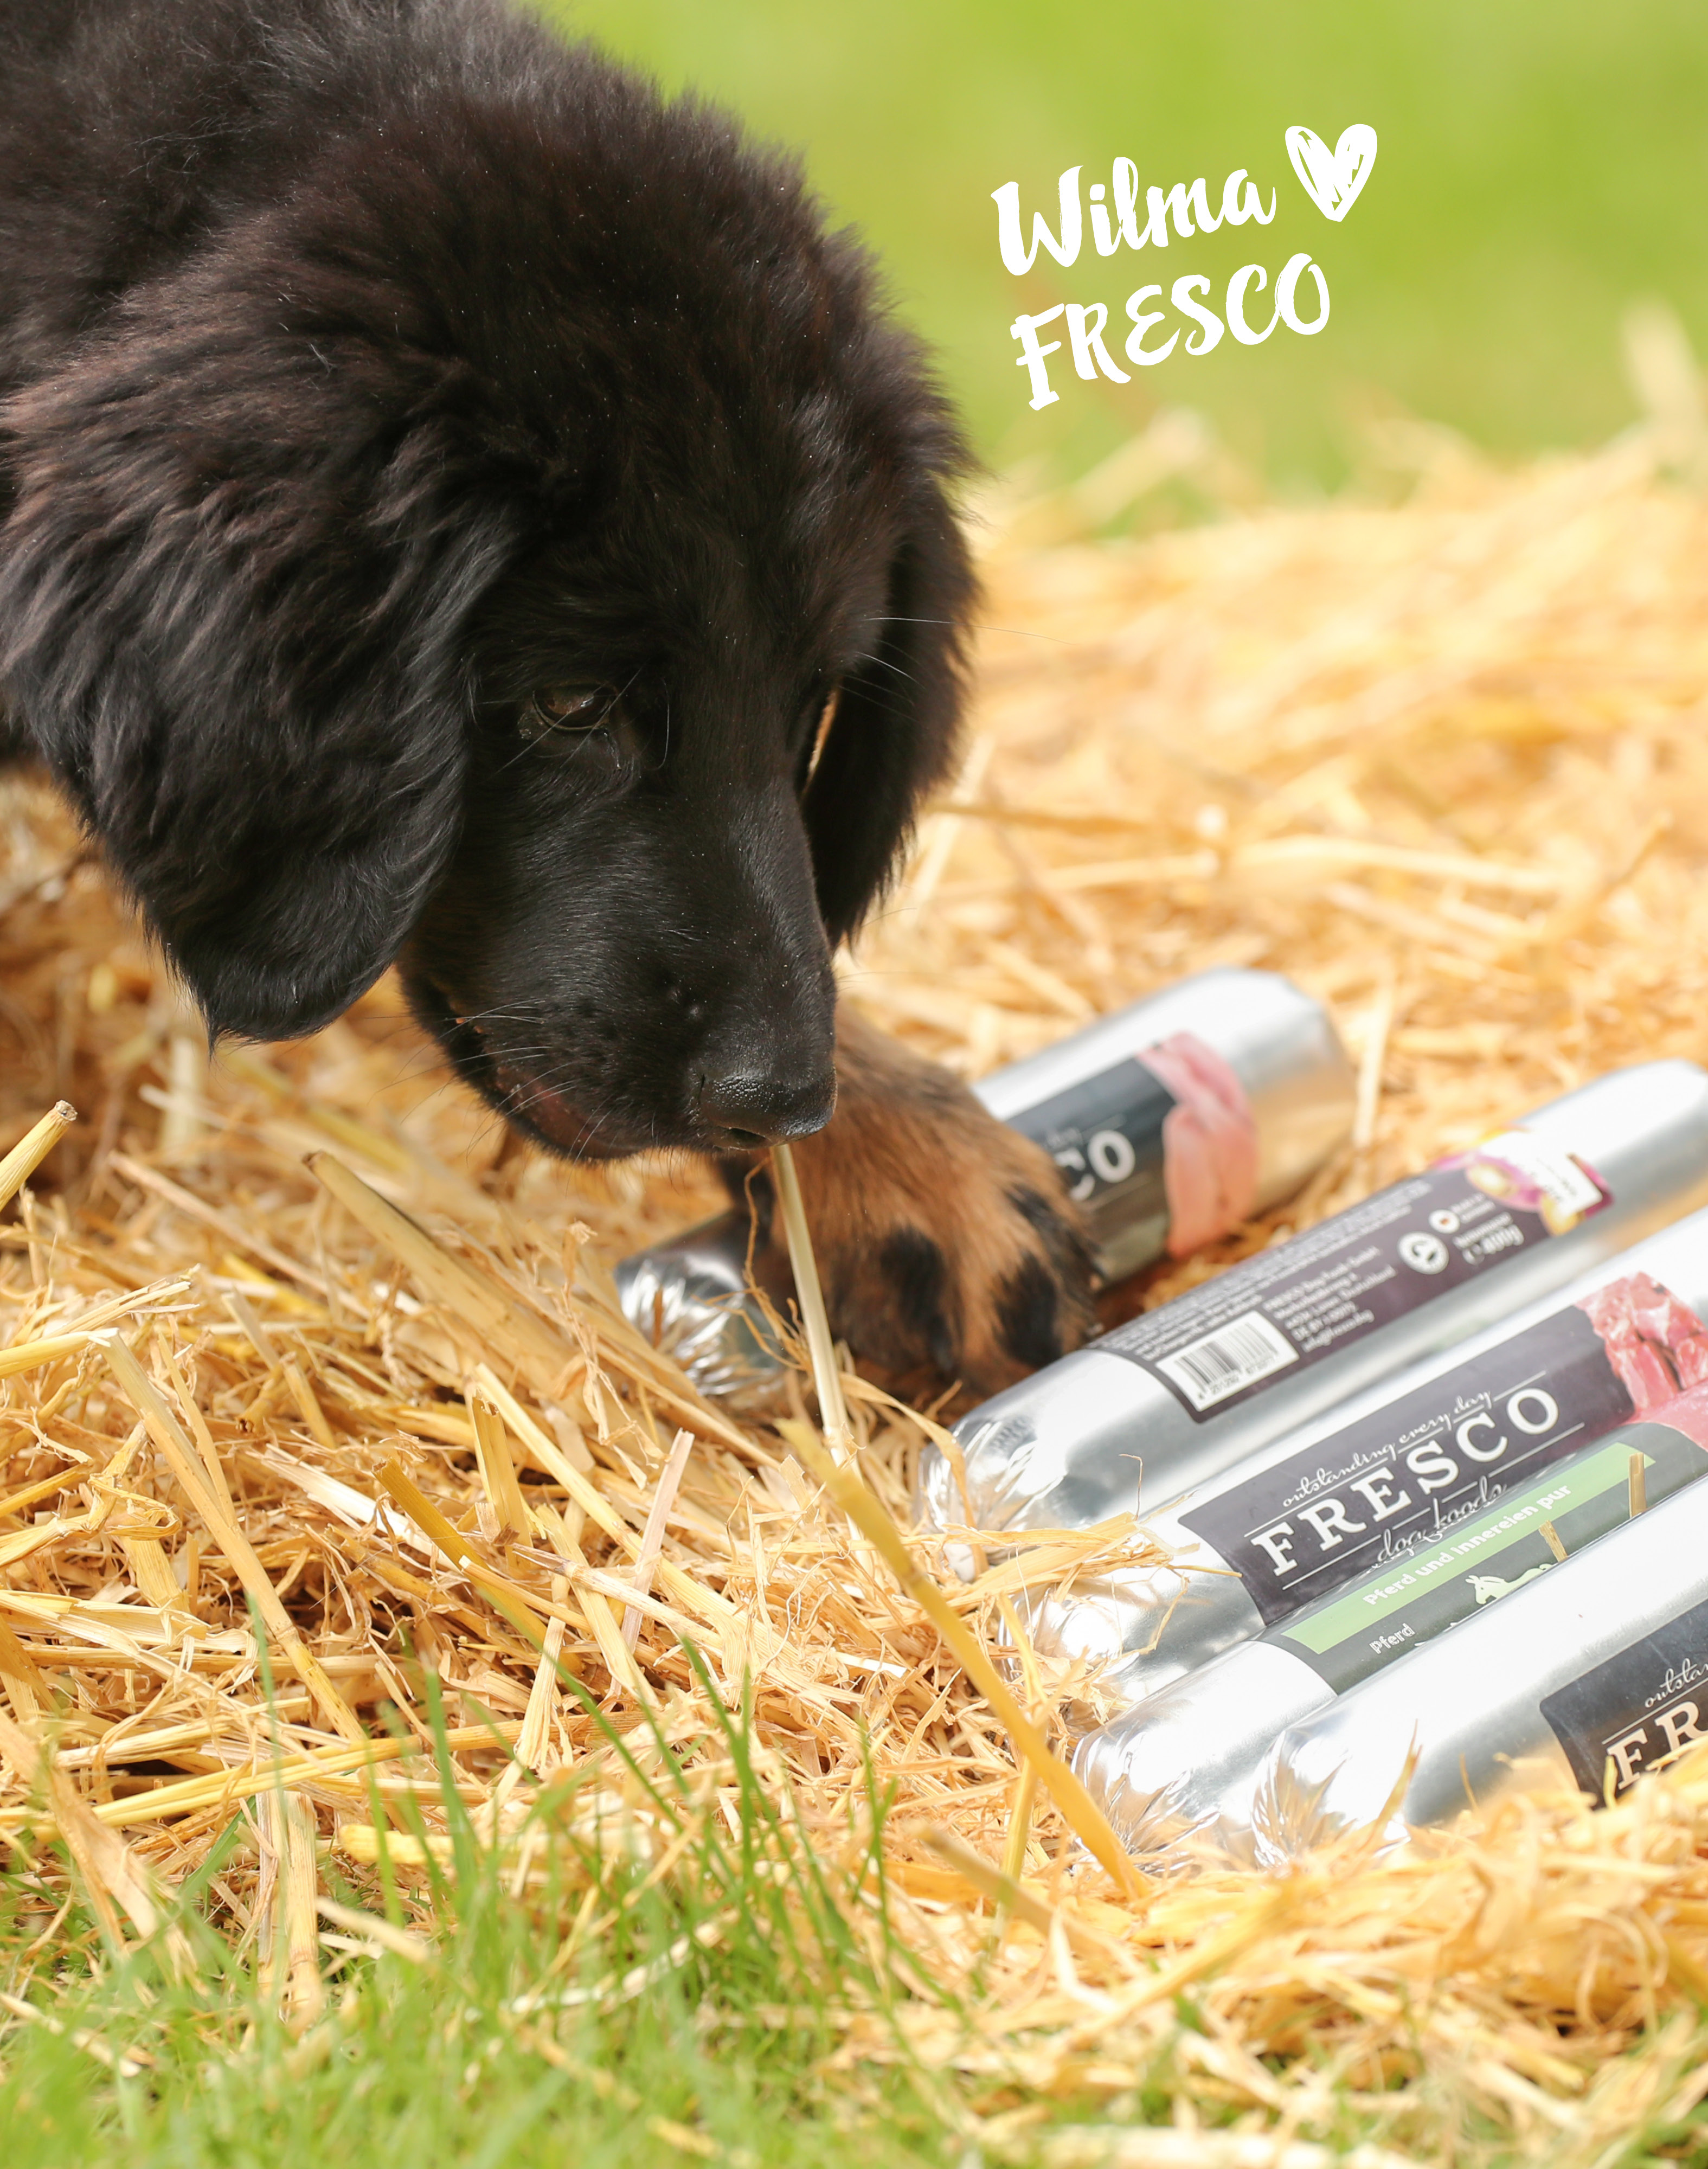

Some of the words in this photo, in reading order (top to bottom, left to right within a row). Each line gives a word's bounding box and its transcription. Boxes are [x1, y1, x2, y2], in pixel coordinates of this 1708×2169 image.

[1250, 1388, 1559, 1577] FRESCO
[1283, 1442, 1397, 1508] outstanding
[1399, 1413, 1453, 1443] every
[1454, 1390, 1492, 1415] day
[1362, 1574, 1417, 1606] Pferd
[1415, 1551, 1455, 1576] und
[1450, 1505, 1539, 1556] Innereien
[1536, 1485, 1572, 1510] pur
[1369, 1622, 1416, 1654] Pferd
